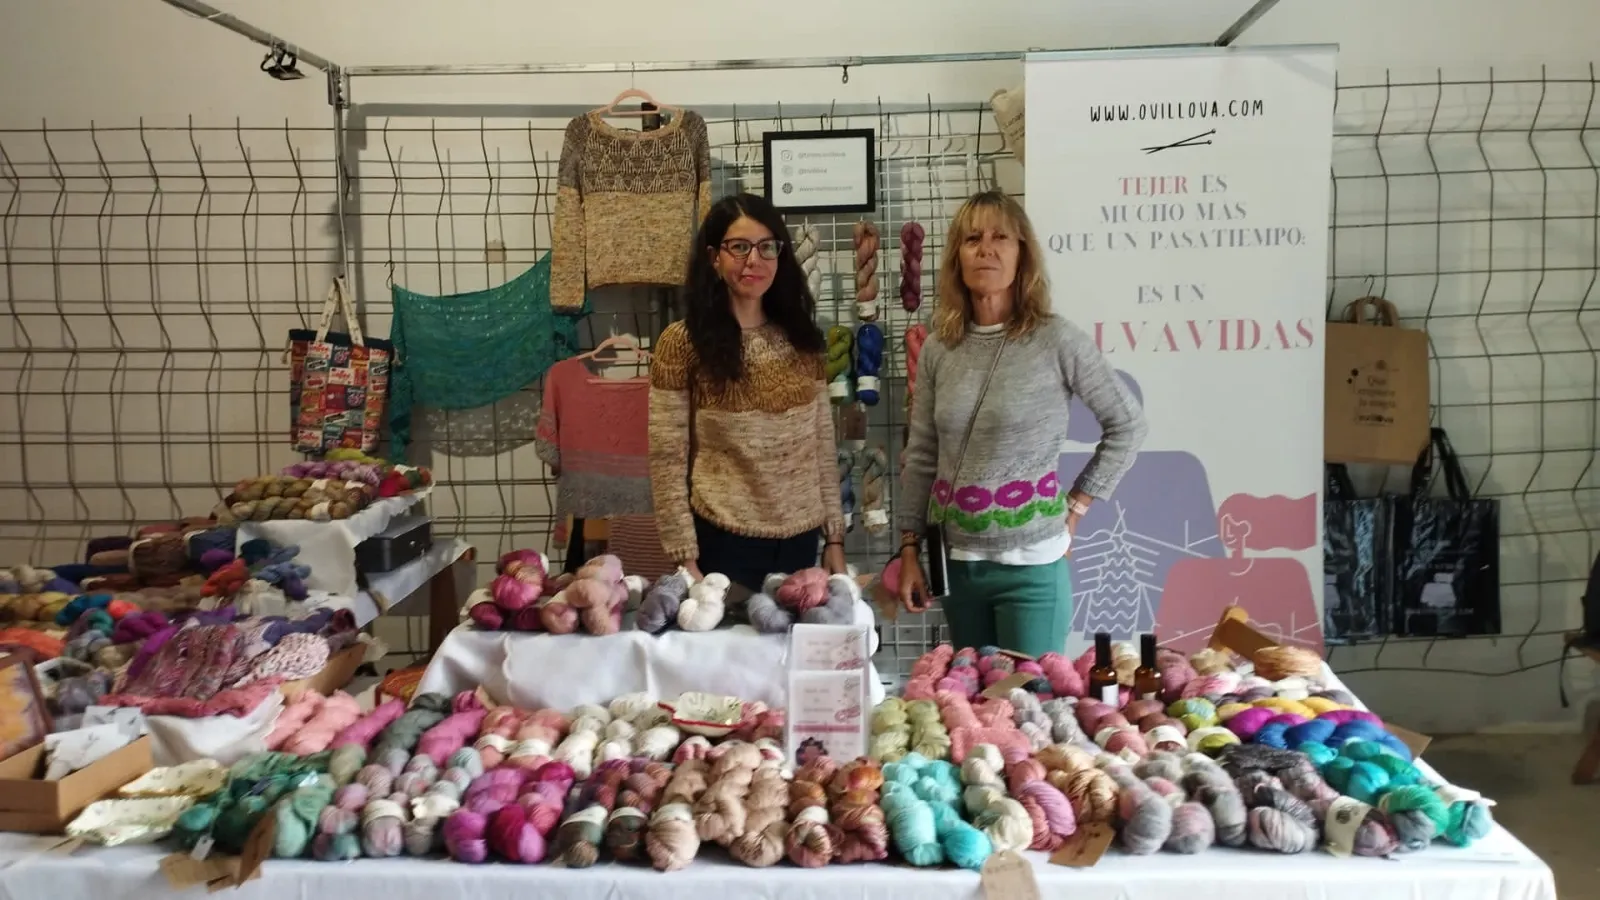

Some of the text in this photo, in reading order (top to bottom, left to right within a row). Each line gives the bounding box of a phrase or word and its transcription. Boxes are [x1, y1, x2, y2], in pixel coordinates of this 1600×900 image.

[1089, 99, 1264, 123] WWW.OVILLOVA.COM
[1118, 174, 1228, 198] TEJER ES
[1100, 203, 1185, 224] MUCHO
[1048, 226, 1307, 254] QUE UN PASATIEMPO:
[1137, 284, 1206, 305] ES UN
[1093, 318, 1314, 354] LVAVIDAS
